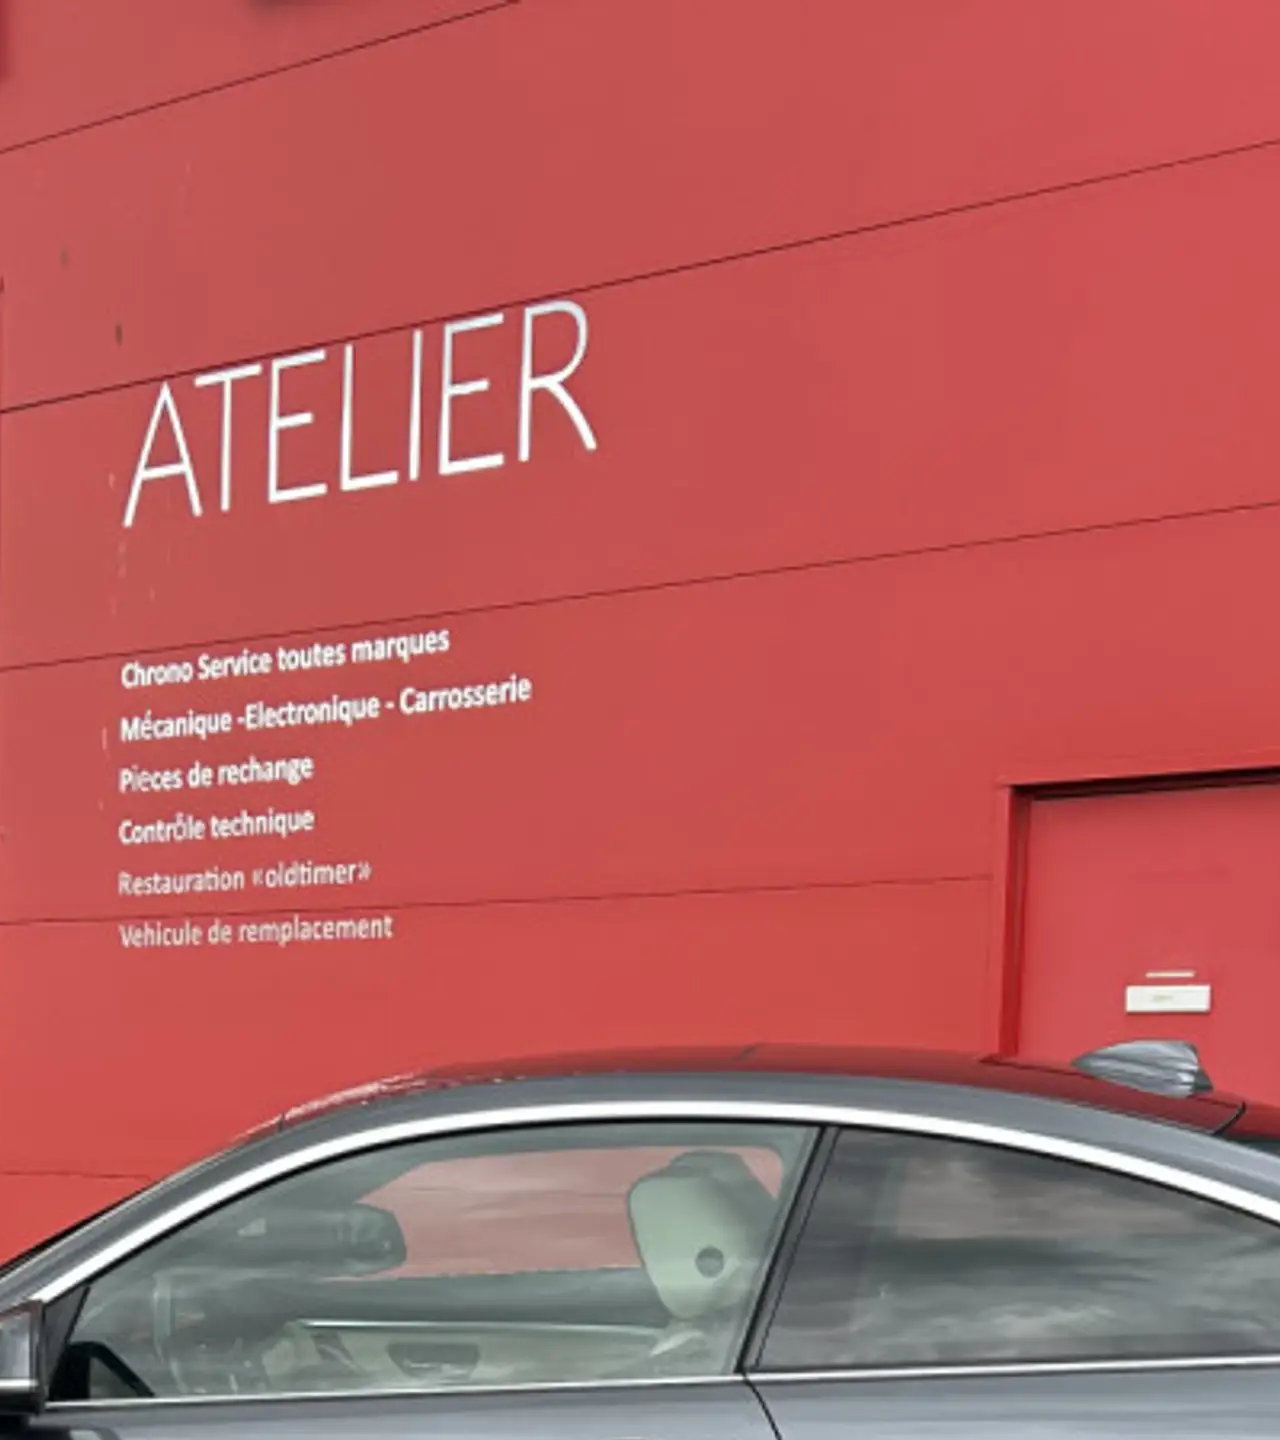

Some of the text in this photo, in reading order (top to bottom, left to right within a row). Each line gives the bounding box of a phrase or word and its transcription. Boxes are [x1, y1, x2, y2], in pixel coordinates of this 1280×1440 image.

[123, 299, 597, 528] ATELIER
[121, 629, 451, 689] Chrono Service toutes marques
[120, 708, 233, 743] Mécanique
[399, 673, 533, 716] Carrosserie
[187, 759, 215, 788] de
[217, 755, 316, 786] rechange
[209, 807, 316, 839] technique
[118, 866, 246, 896] Restauration
[207, 918, 233, 945] de
[238, 914, 394, 947] remplacement
